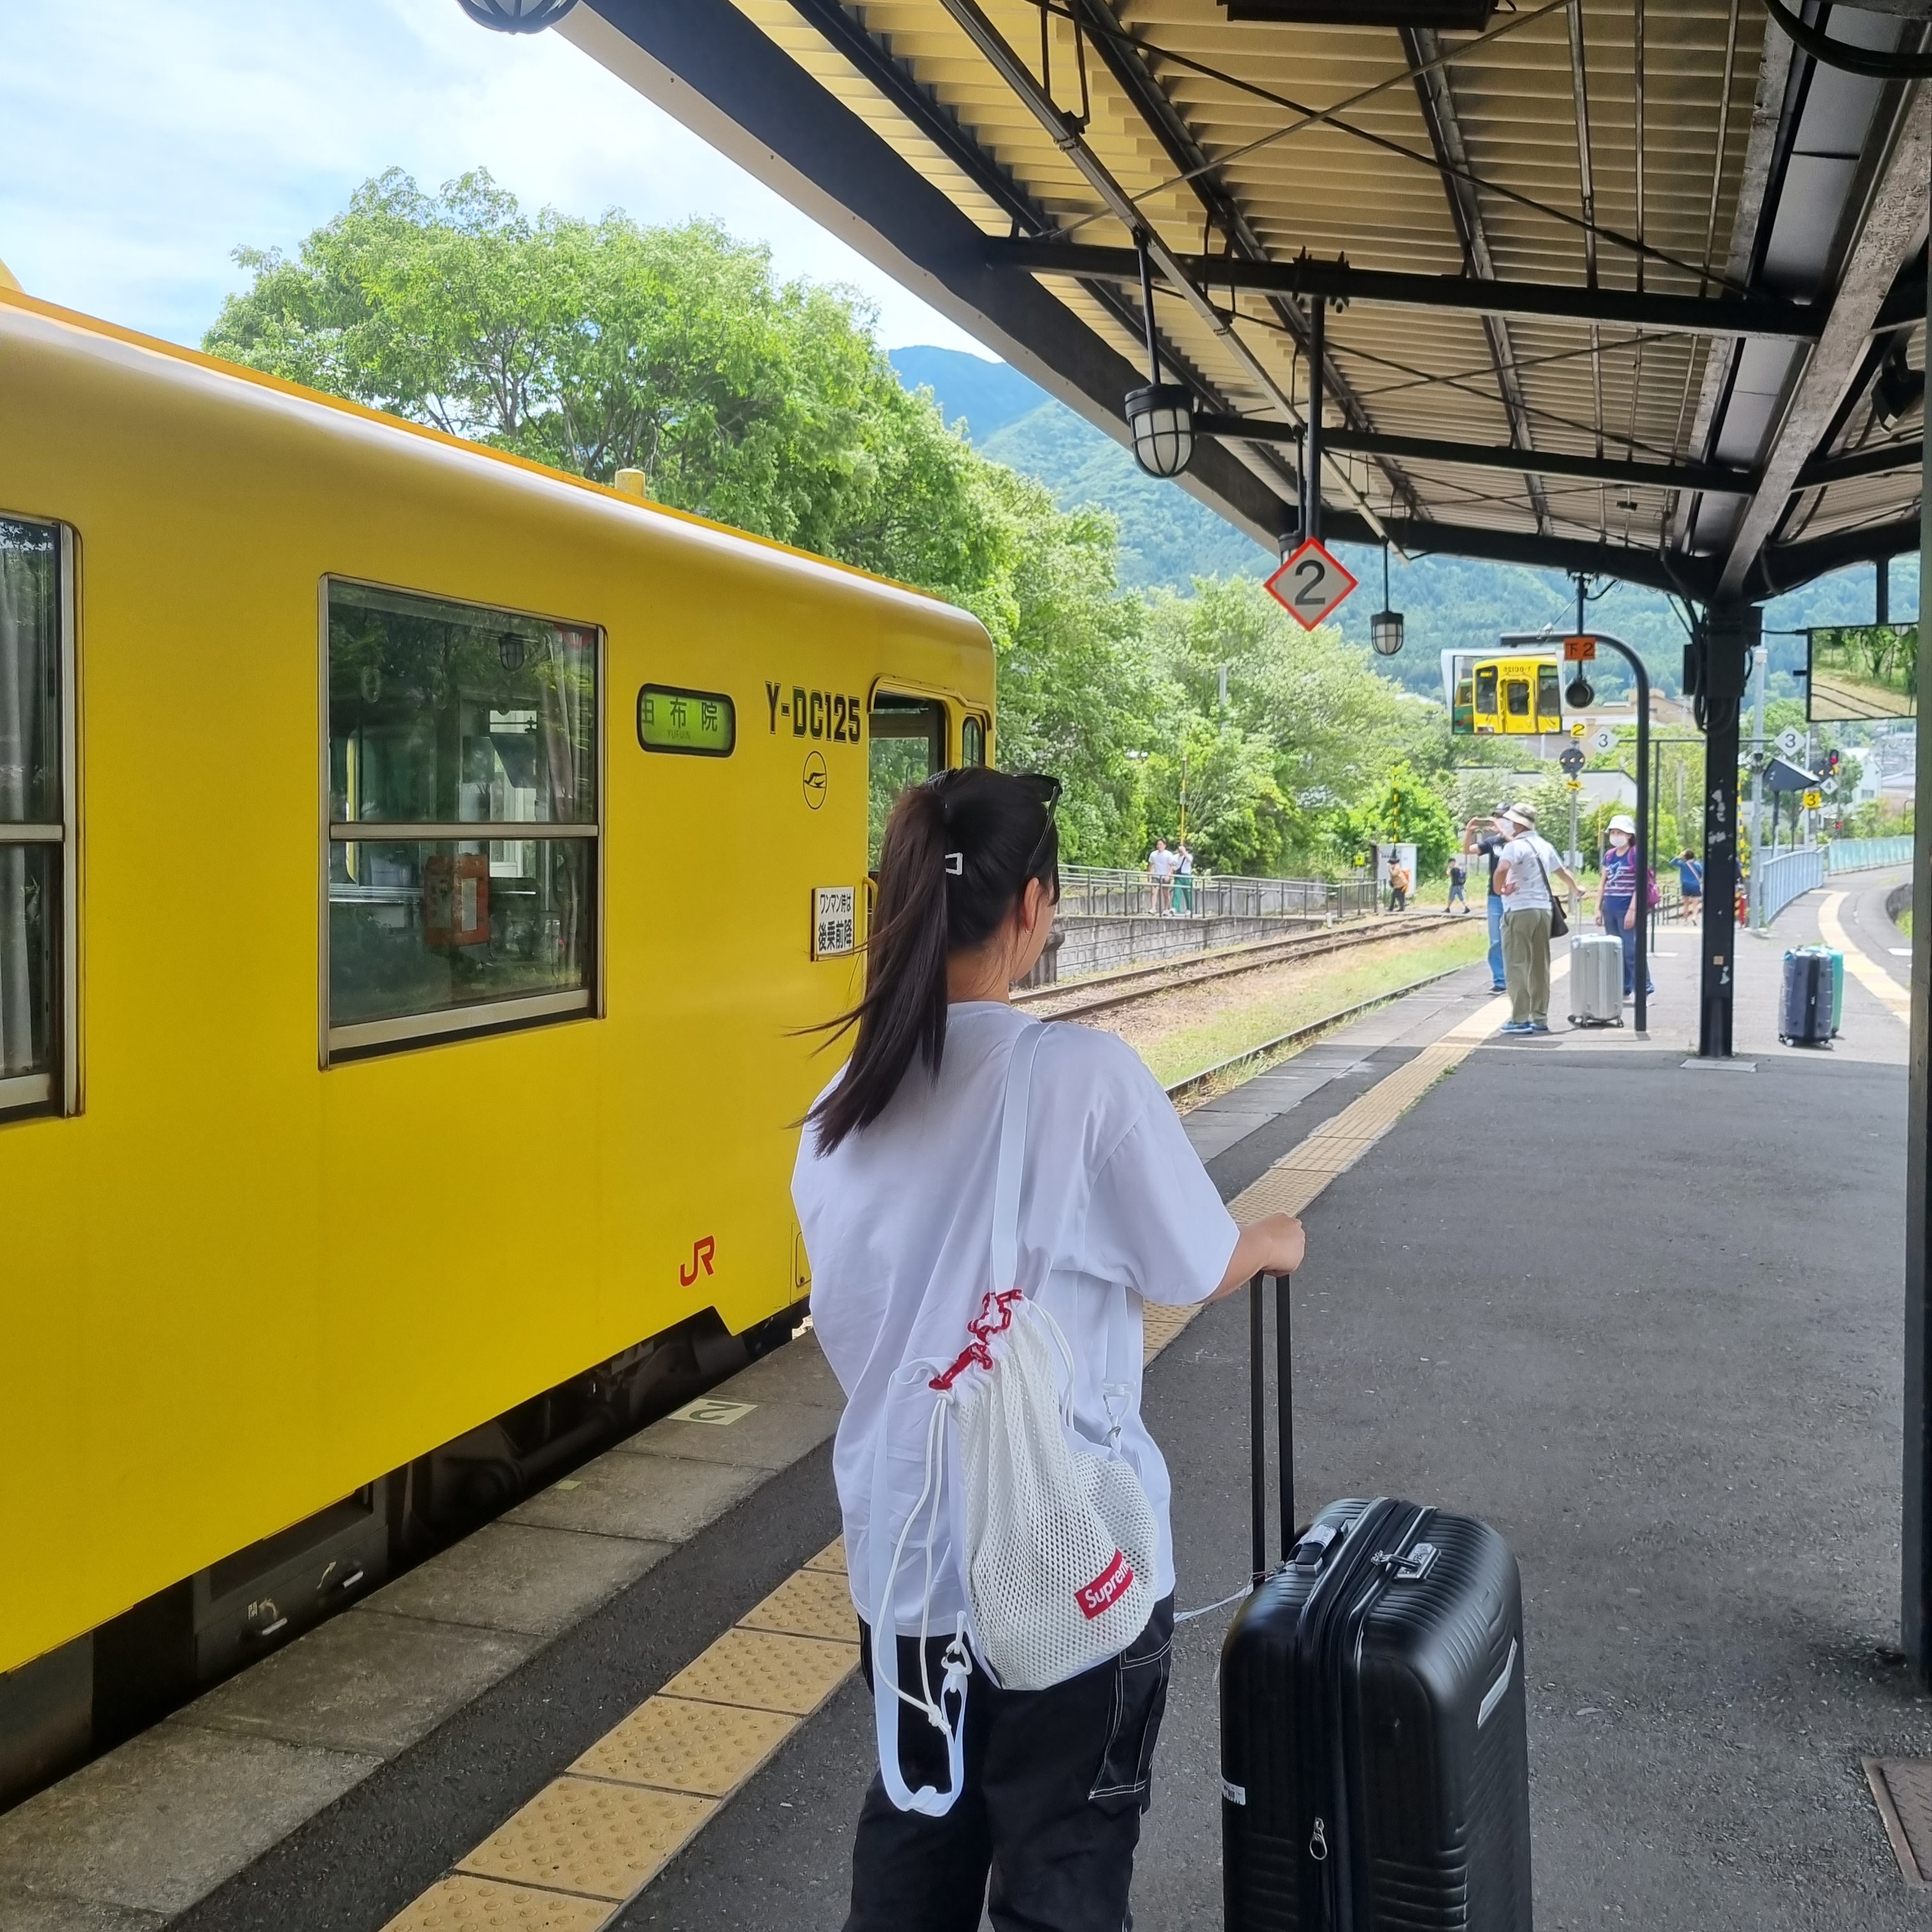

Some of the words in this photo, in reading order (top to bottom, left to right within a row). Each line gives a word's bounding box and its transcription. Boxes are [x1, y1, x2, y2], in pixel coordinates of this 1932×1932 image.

[1295, 560, 1326, 606] 2
[765, 680, 861, 745] Y-DC125
[667, 729, 691, 740] YUFUIN
[1572, 723, 1585, 736] 2
[1598, 733, 1608, 748] 3
[1785, 733, 1796, 748] 3
[1825, 781, 1832, 790] 4
[1807, 793, 1816, 806] 3
[820, 893, 852, 914] ワンマン時は
[818, 919, 852, 952] 後乗前降
[680, 1235, 715, 1287] JR
[689, 1402, 742, 1421] 2
